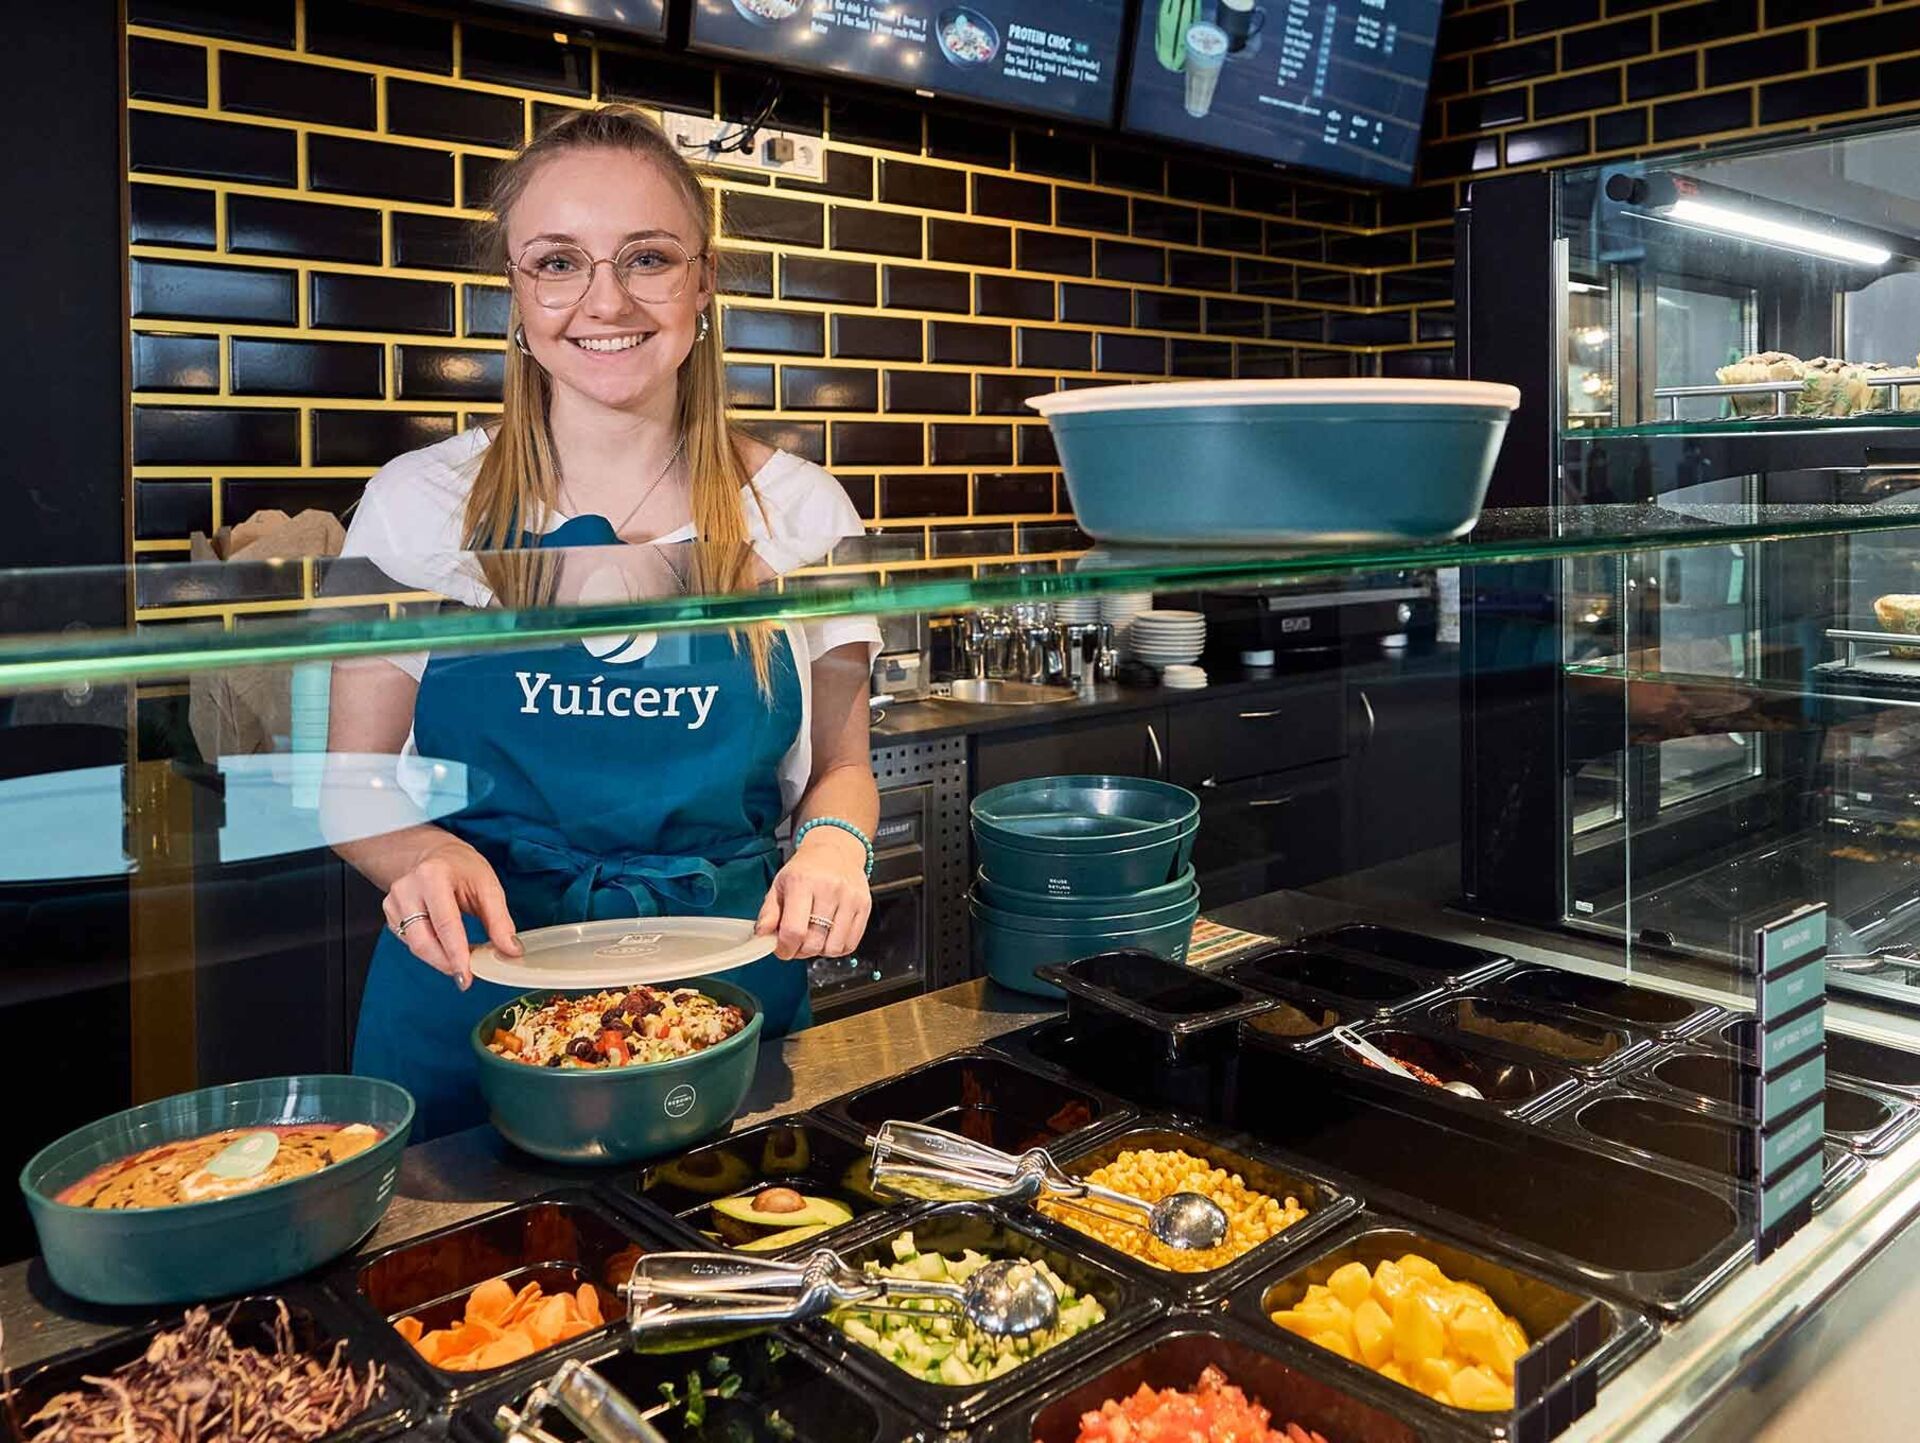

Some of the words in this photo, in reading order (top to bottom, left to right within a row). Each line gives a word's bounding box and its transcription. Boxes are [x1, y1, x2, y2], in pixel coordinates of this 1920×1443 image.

[1008, 24, 1047, 45] PROTEIN
[1047, 33, 1072, 52] CHOC
[515, 671, 719, 730] Yuícery
